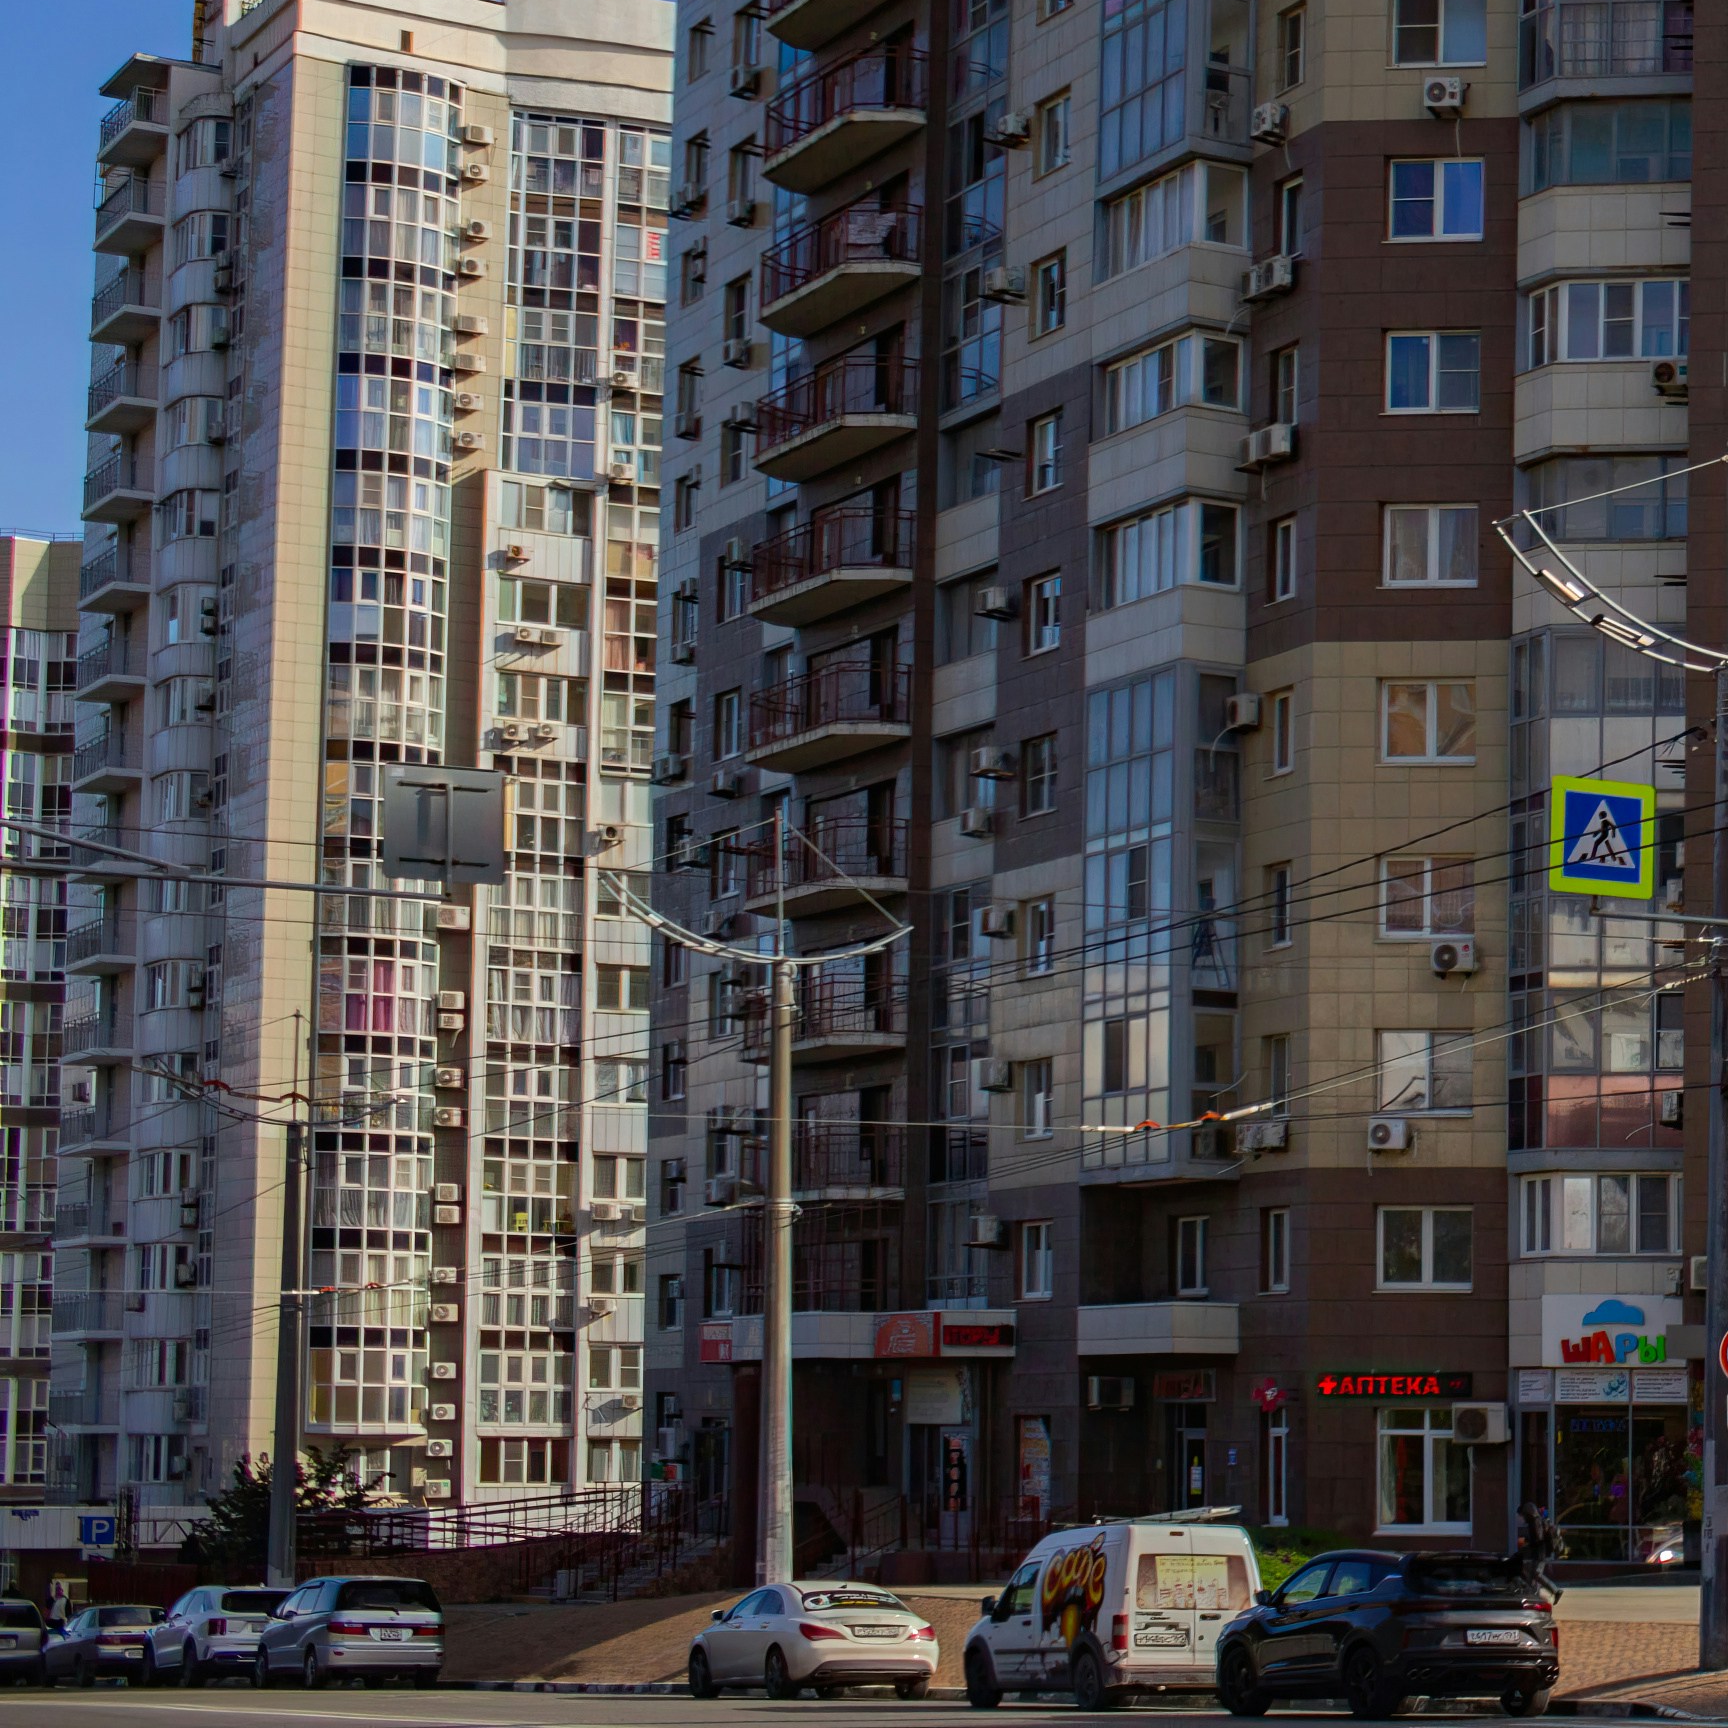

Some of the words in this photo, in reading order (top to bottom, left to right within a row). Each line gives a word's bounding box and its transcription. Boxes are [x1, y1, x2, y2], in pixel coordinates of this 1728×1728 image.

[1561, 1331, 1667, 1364] ШАРЫ
[1339, 1376, 1440, 1395] АПТЕКА
[91, 1519, 111, 1543] P
